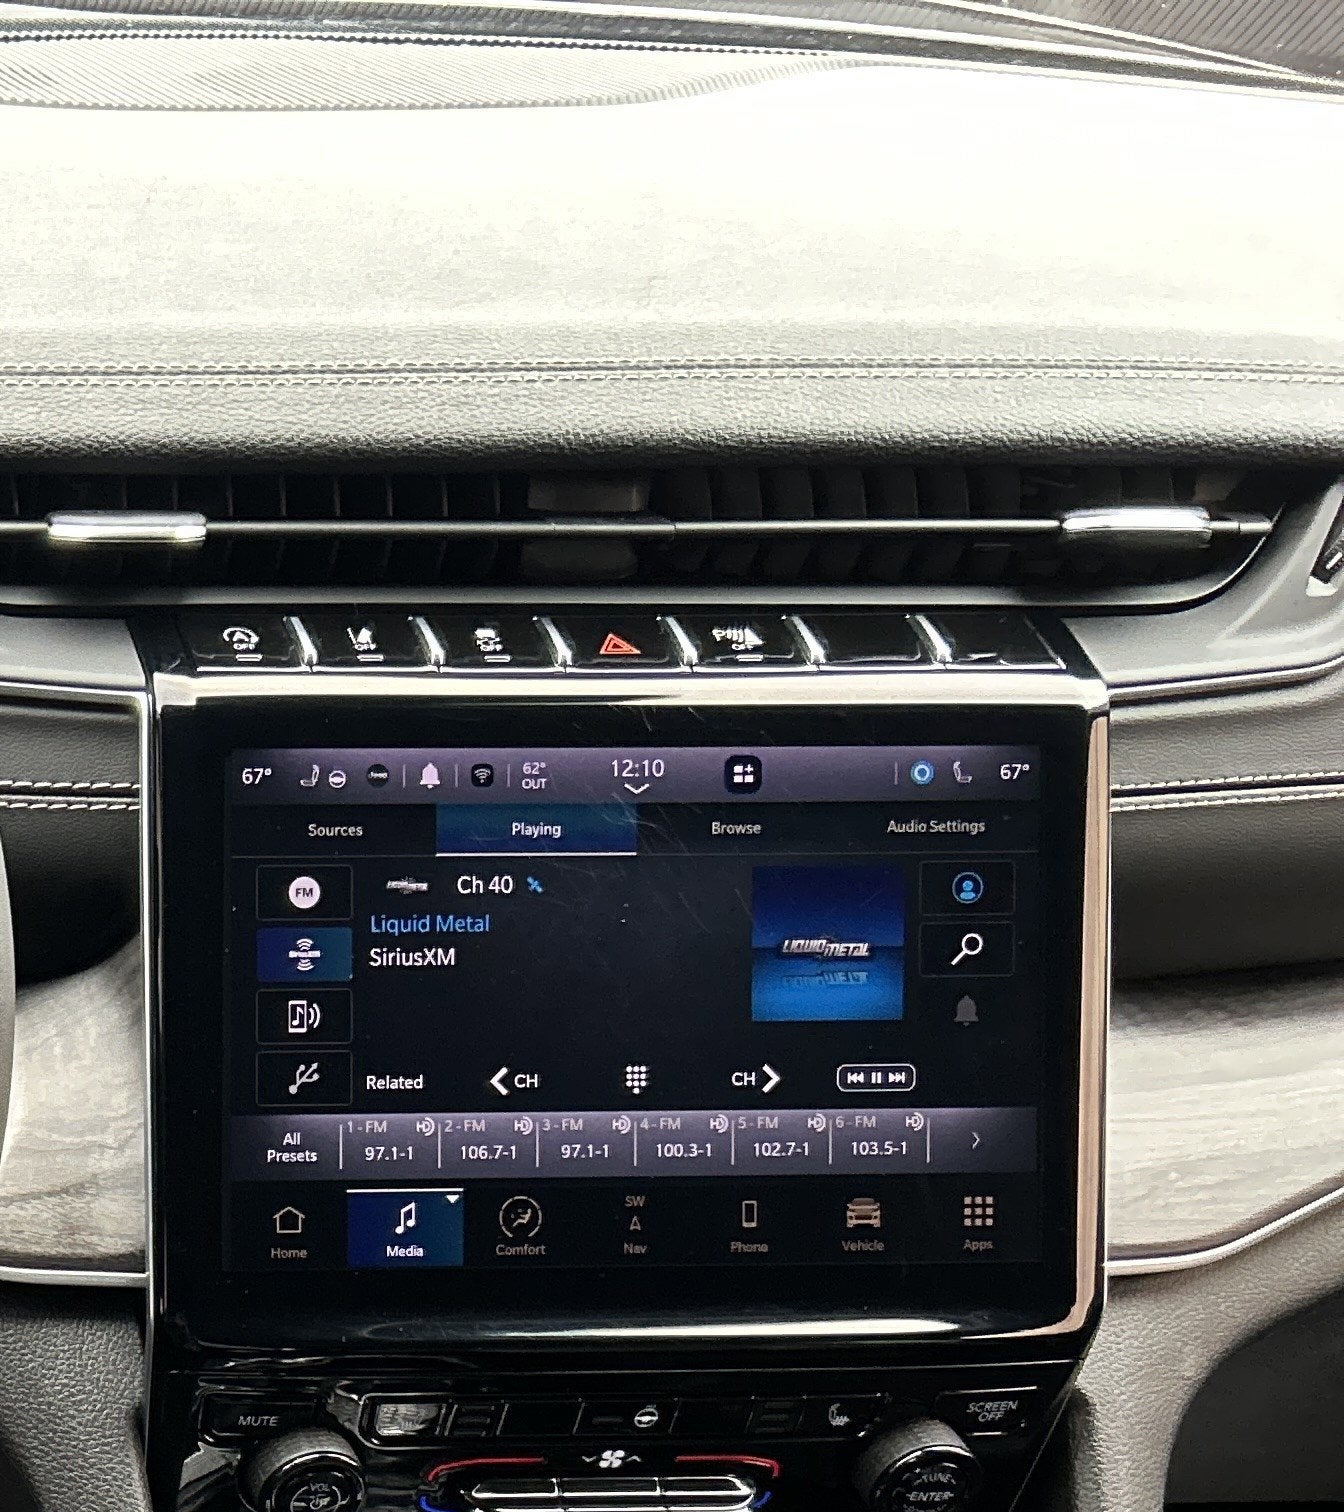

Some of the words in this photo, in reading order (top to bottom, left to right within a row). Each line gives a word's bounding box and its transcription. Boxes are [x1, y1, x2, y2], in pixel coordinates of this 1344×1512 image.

[232, 642, 255, 650] OFF
[522, 762, 546, 775] 62°
[611, 759, 664, 778] 12:10
[999, 763, 1030, 780] 67°
[241, 767, 272, 785] 67°
[521, 777, 547, 790] OUT
[308, 823, 363, 838] Sources
[512, 821, 562, 839] Playing
[711, 821, 762, 835] Browse
[886, 820, 927, 833] Audio
[928, 819, 986, 836] Settings
[294, 887, 315, 898] FM
[457, 876, 484, 895] Ch
[488, 876, 514, 895] 40
[370, 915, 431, 937] Liquid
[436, 914, 490, 933] Metal
[782, 939, 827, 954] LIQUID
[823, 943, 870, 957] METAL
[369, 948, 456, 966] SiriusXM
[366, 1074, 424, 1090] Related
[514, 1074, 539, 1089] CH
[731, 1071, 756, 1087] CH
[282, 1132, 302, 1146] All
[364, 1147, 413, 1161] 97.1-1
[460, 1145, 517, 1160] 106.7-1
[560, 1144, 609, 1159] 97.1-1
[655, 1143, 712, 1158] 100.3-1
[753, 1142, 810, 1156] 102.7-1
[851, 1141, 907, 1156] 103.5-1
[266, 1149, 318, 1163] Presets
[624, 1195, 646, 1207] SW
[386, 1245, 424, 1257] Media
[495, 1243, 546, 1256] Comfort
[623, 1242, 647, 1254] Nav
[729, 1241, 769, 1253] Phone
[841, 1239, 885, 1252] Vehicle
[963, 1238, 994, 1253] Apps
[270, 1247, 308, 1259] Home
[966, 1400, 1018, 1414] SCREEN
[238, 1416, 281, 1427] MUTE
[977, 1411, 1004, 1422] OFF
